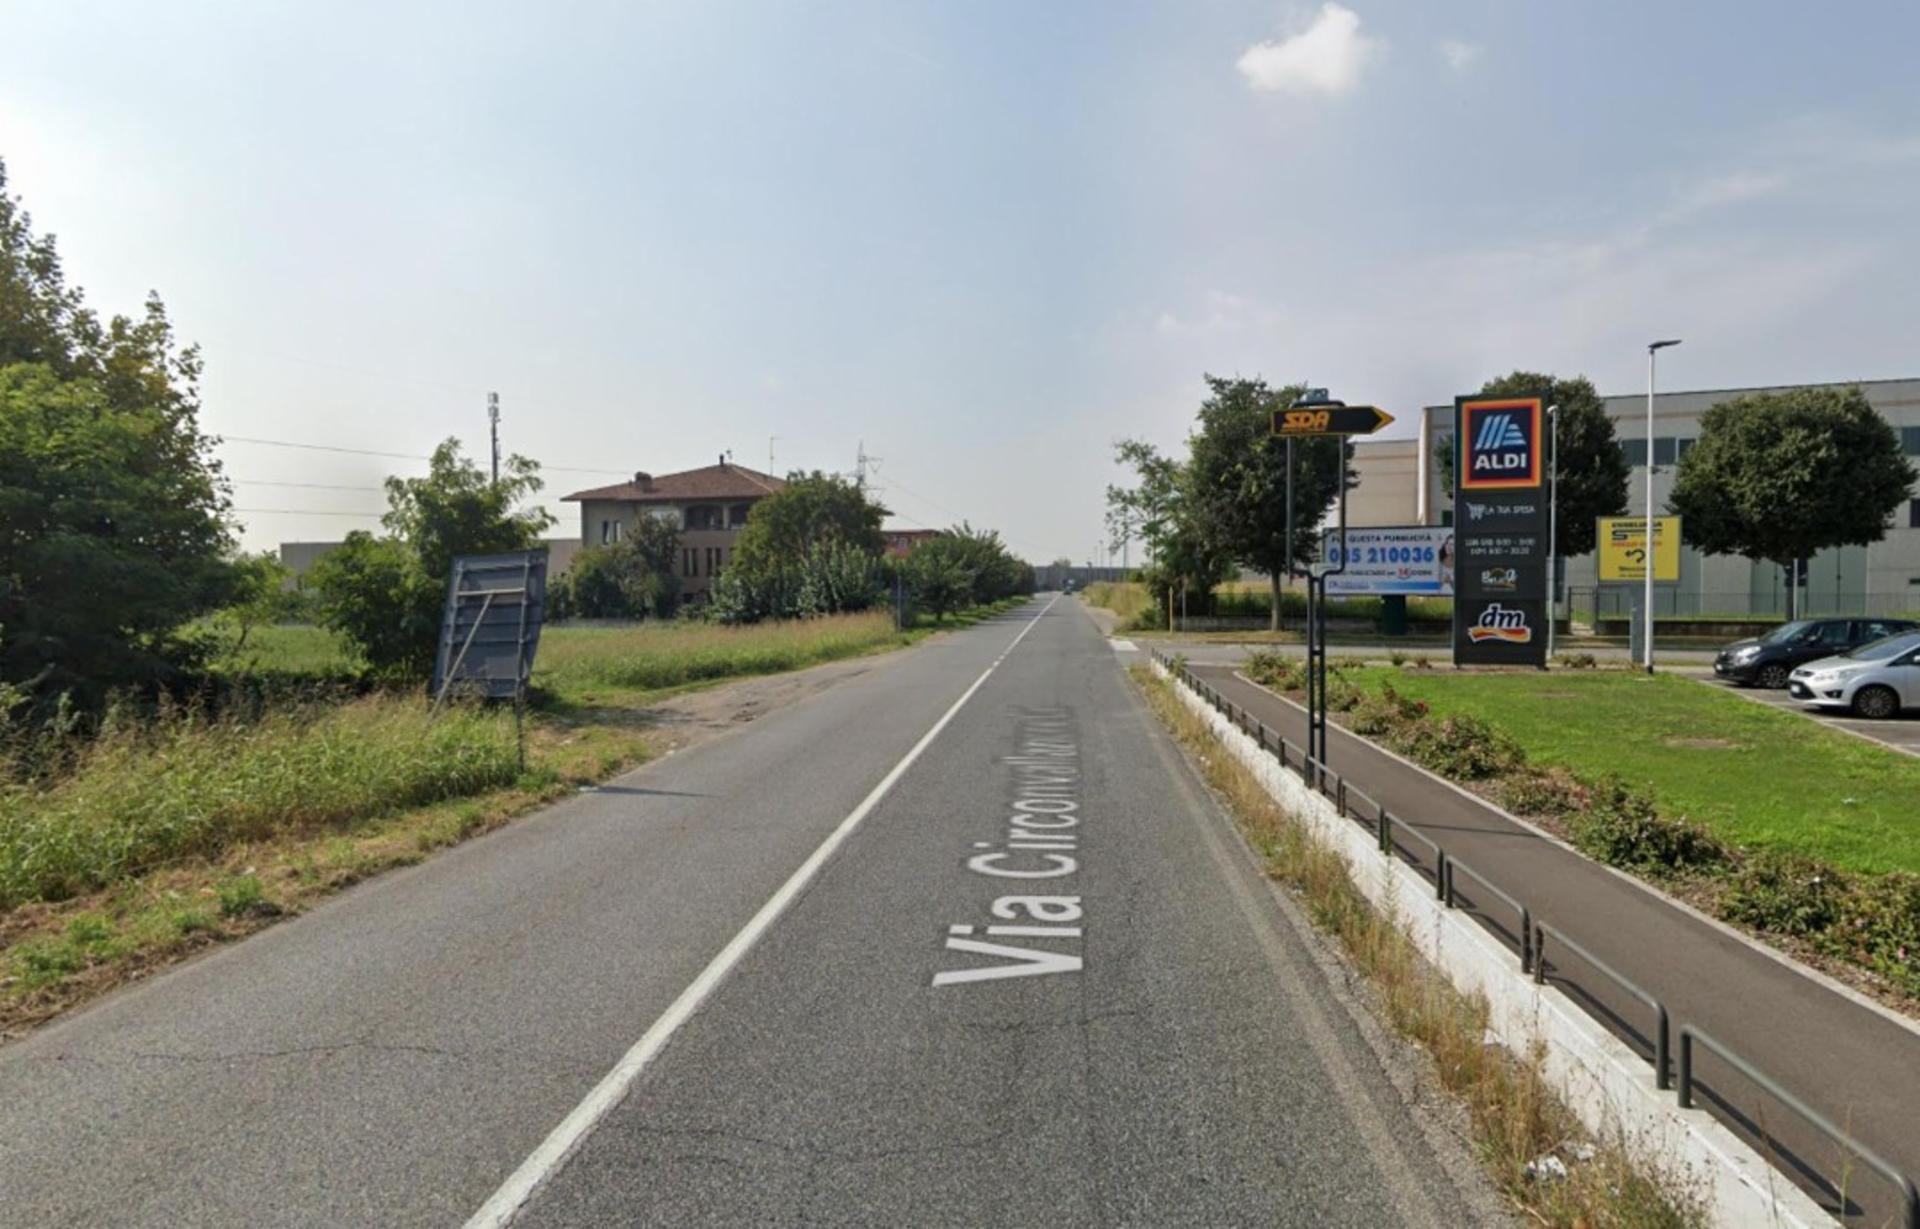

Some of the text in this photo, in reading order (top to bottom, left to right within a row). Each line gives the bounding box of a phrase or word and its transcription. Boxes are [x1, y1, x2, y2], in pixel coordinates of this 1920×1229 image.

[1282, 410, 1330, 431] SDA
[1474, 453, 1527, 470] ALDI
[1348, 534, 1381, 543] QUESTA
[1367, 546, 1434, 563] 210036
[1479, 603, 1525, 629] dm
